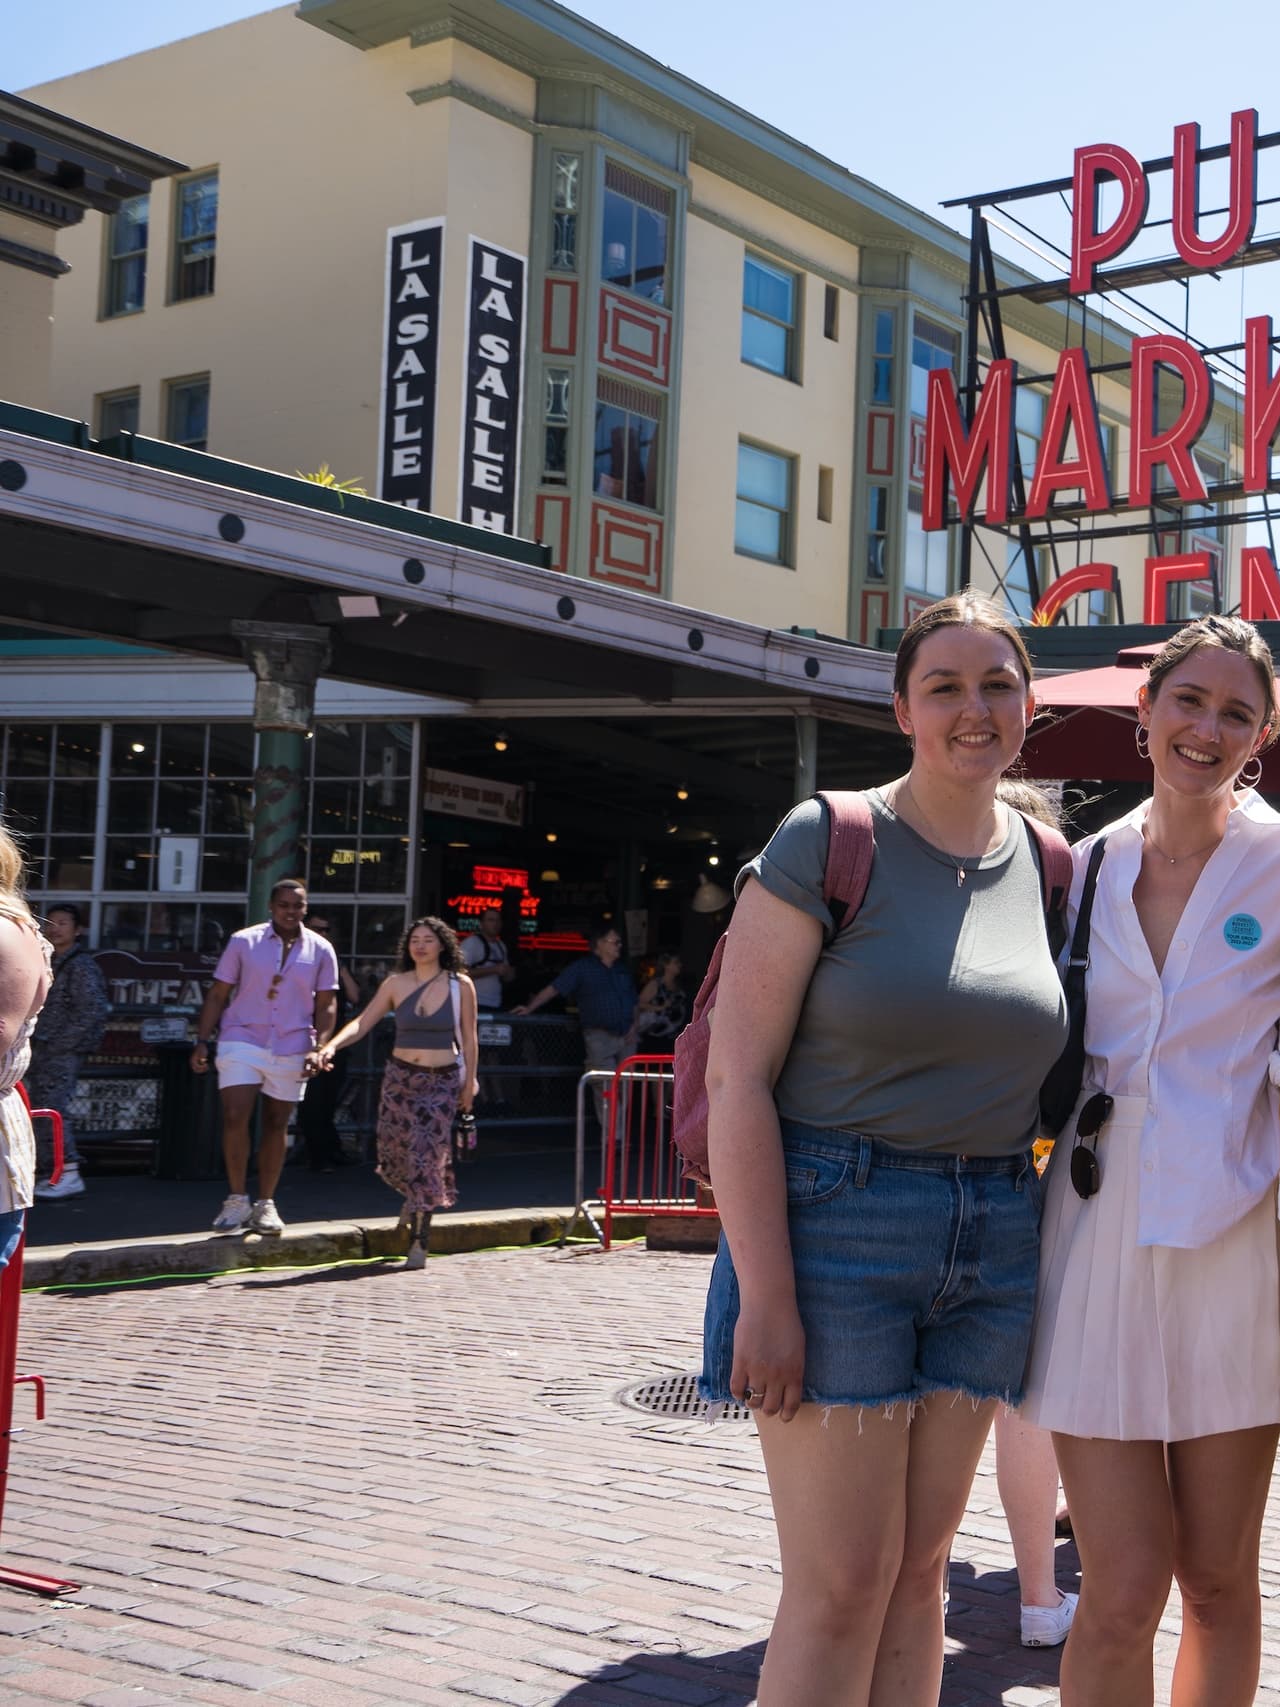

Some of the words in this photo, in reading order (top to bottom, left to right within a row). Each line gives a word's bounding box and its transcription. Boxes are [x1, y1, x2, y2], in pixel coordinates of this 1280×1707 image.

[396, 241, 431, 303] LA
[478, 252, 513, 322] LA
[392, 314, 429, 476] SALLE
[471, 333, 510, 493] SALLE
